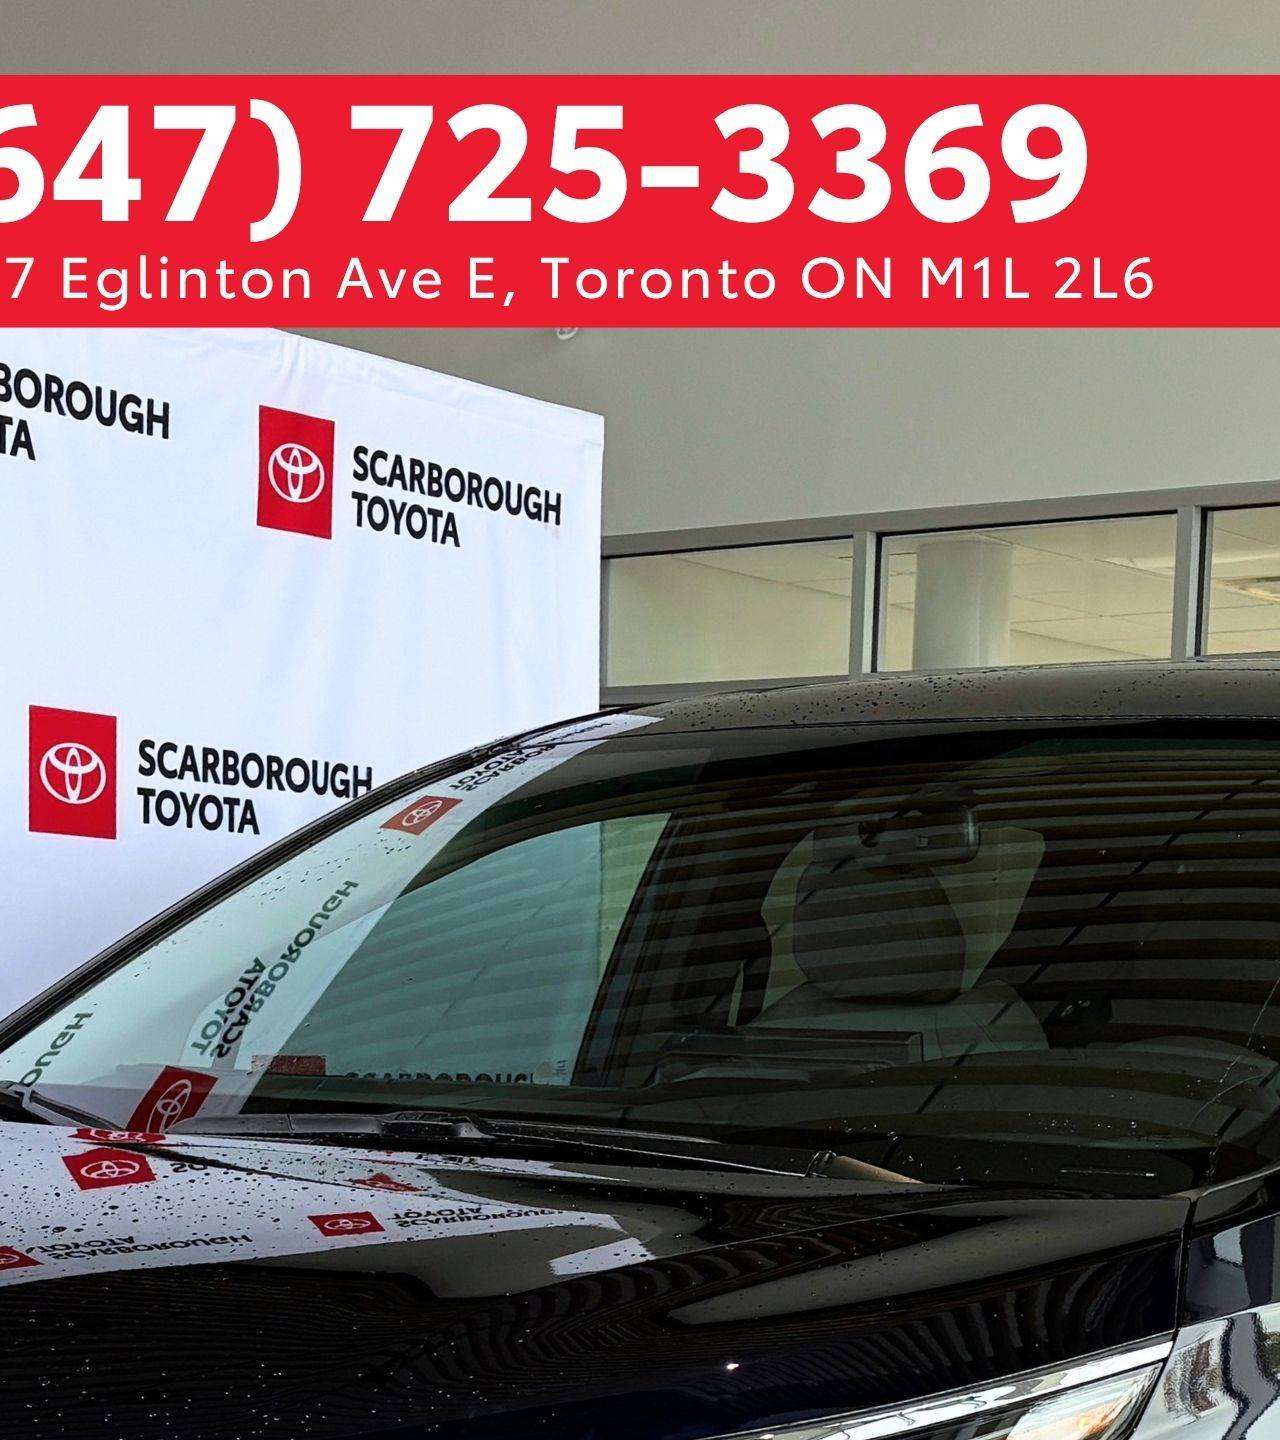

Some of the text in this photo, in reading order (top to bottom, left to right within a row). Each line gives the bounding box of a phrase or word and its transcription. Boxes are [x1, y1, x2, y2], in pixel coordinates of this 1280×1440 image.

[352, 445, 562, 526] SCARBOROUGH
[351, 490, 461, 548] TOYOTA
[138, 738, 373, 799] SCARBOROUGH
[136, 787, 260, 835] TOYOTA
